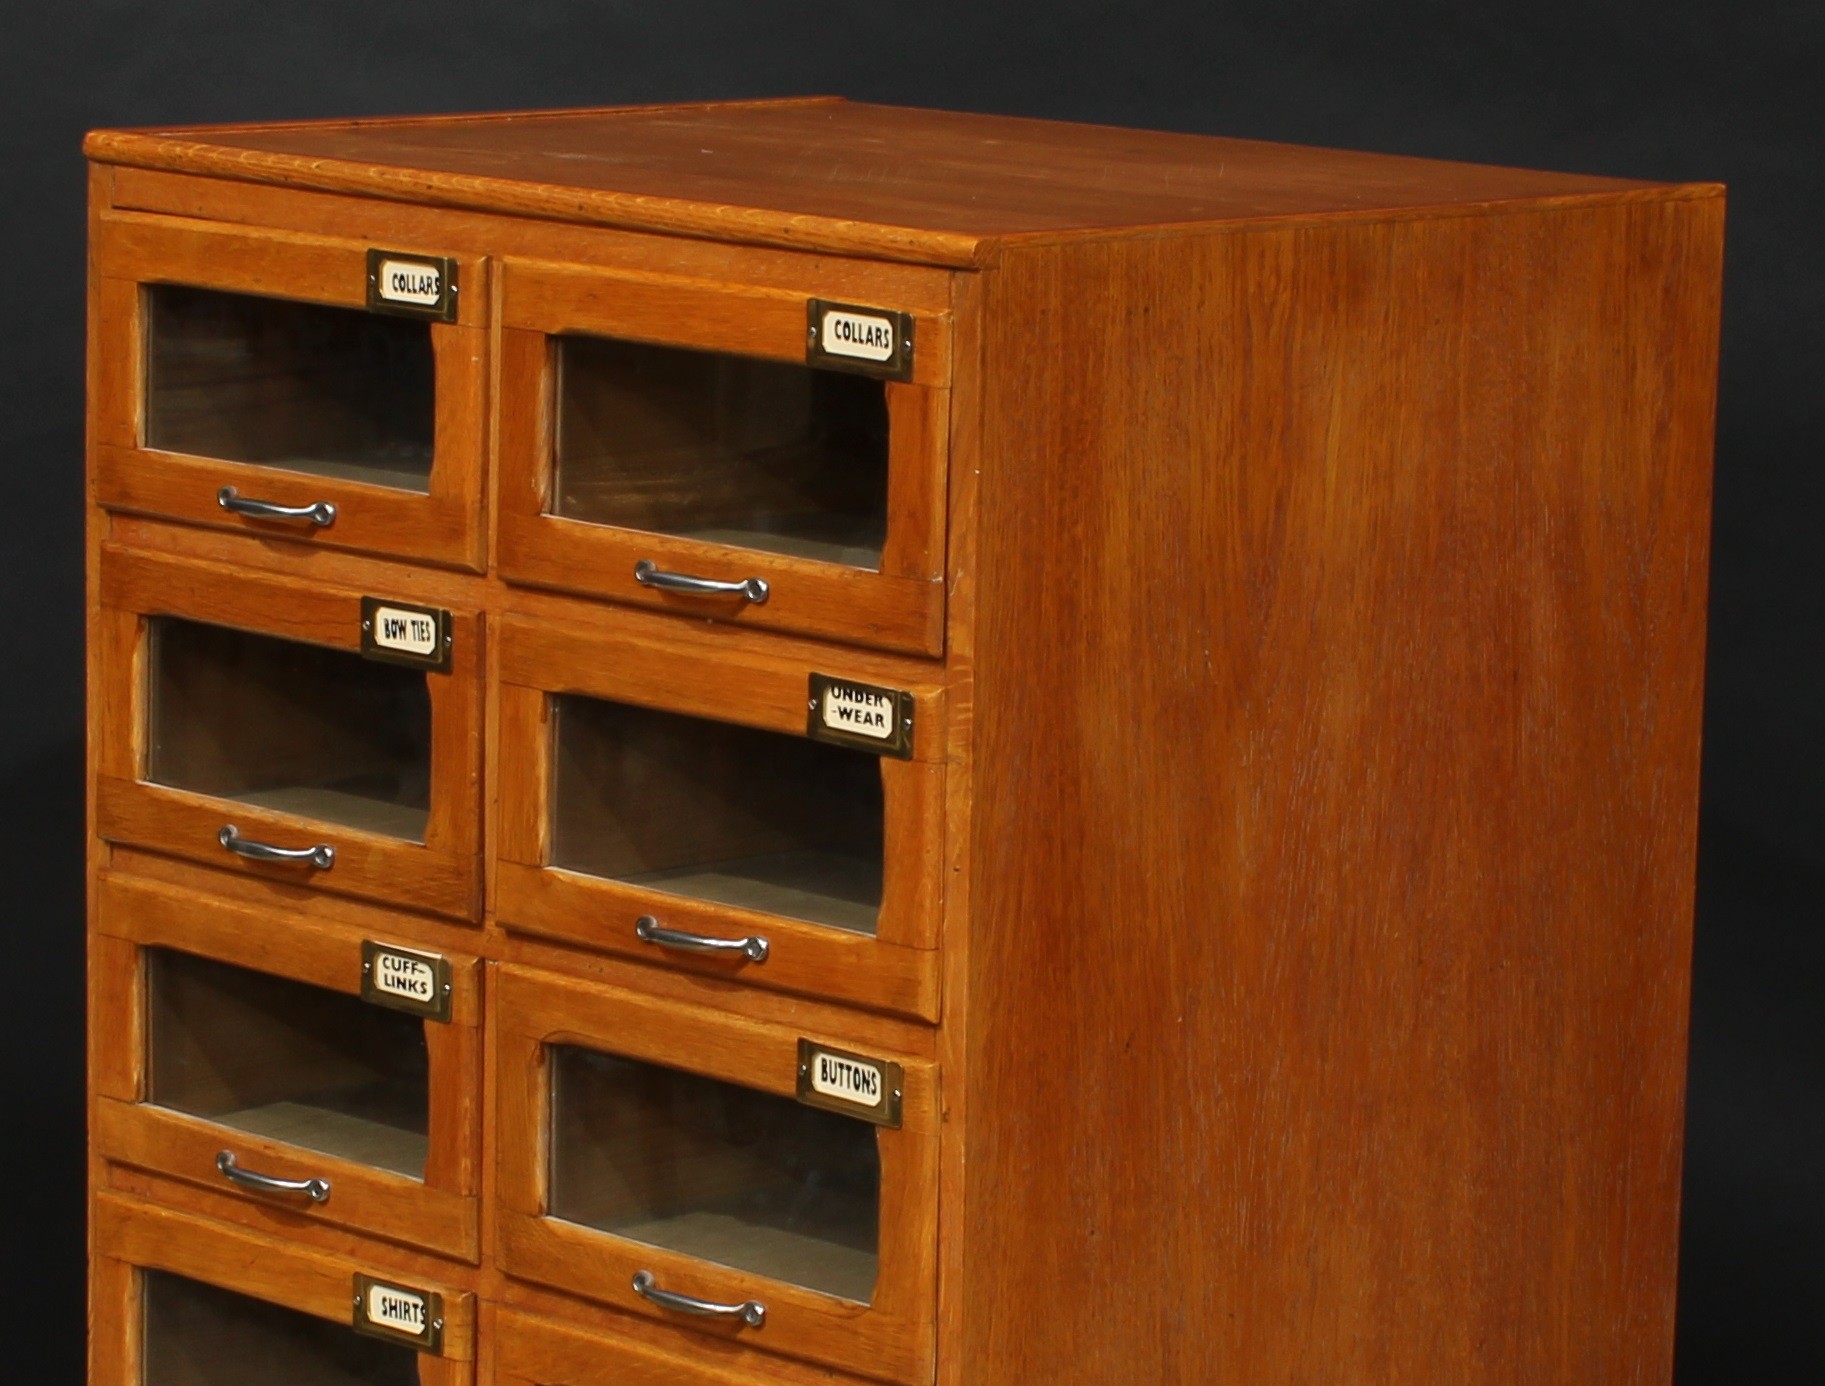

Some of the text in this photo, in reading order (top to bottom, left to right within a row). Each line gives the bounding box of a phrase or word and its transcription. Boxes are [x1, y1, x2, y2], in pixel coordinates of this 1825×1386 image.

[392, 271, 440, 296] COLLARS
[833, 318, 891, 351] COLLARS
[383, 618, 431, 642] BOW TIES
[831, 686, 884, 708] UNDER
[831, 706, 885, 728] -WEAR
[382, 955, 426, 975] CUFF-
[384, 973, 428, 995] LINKS
[821, 1057, 877, 1096] BUTTONS
[381, 1296, 426, 1326] SHIRTS
